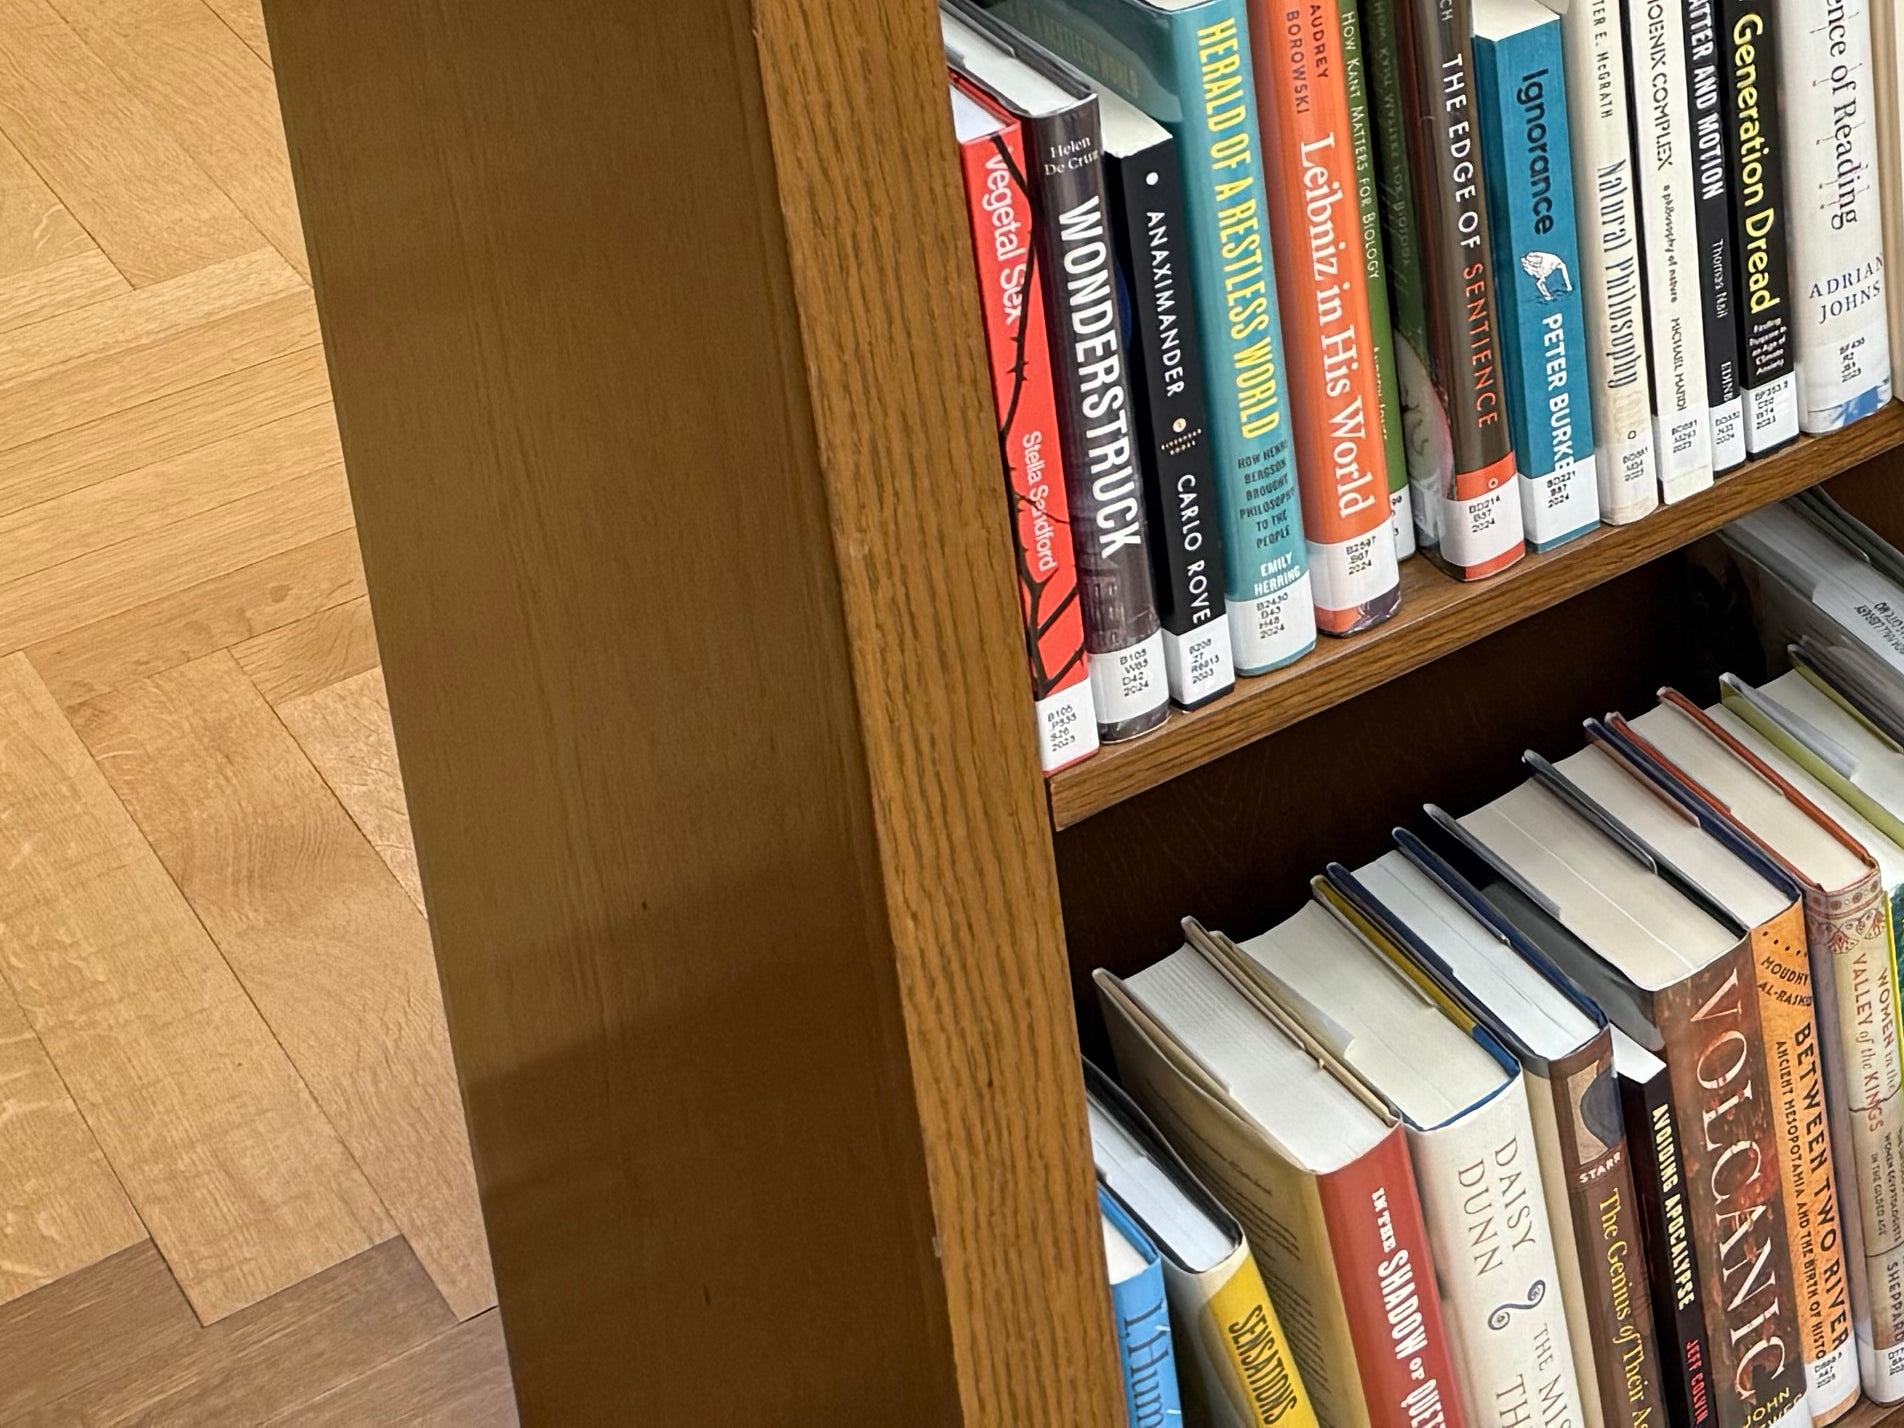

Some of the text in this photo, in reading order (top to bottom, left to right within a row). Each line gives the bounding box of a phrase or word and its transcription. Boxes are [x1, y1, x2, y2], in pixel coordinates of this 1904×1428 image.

[1196, 17, 1280, 440] HERALD OF A RESTLESS WORLD
[1300, 132, 1377, 519] Leibniz in His World
[1442, 52, 1499, 430] THE EDGE OF SENTIENCE
[1513, 66, 1556, 236] Ignorance
[1732, 10, 1780, 316] Generation Dread
[1057, 195, 1142, 560] WONDERSTRUCK
[1688, 967, 1787, 1400] VOLCANIC
